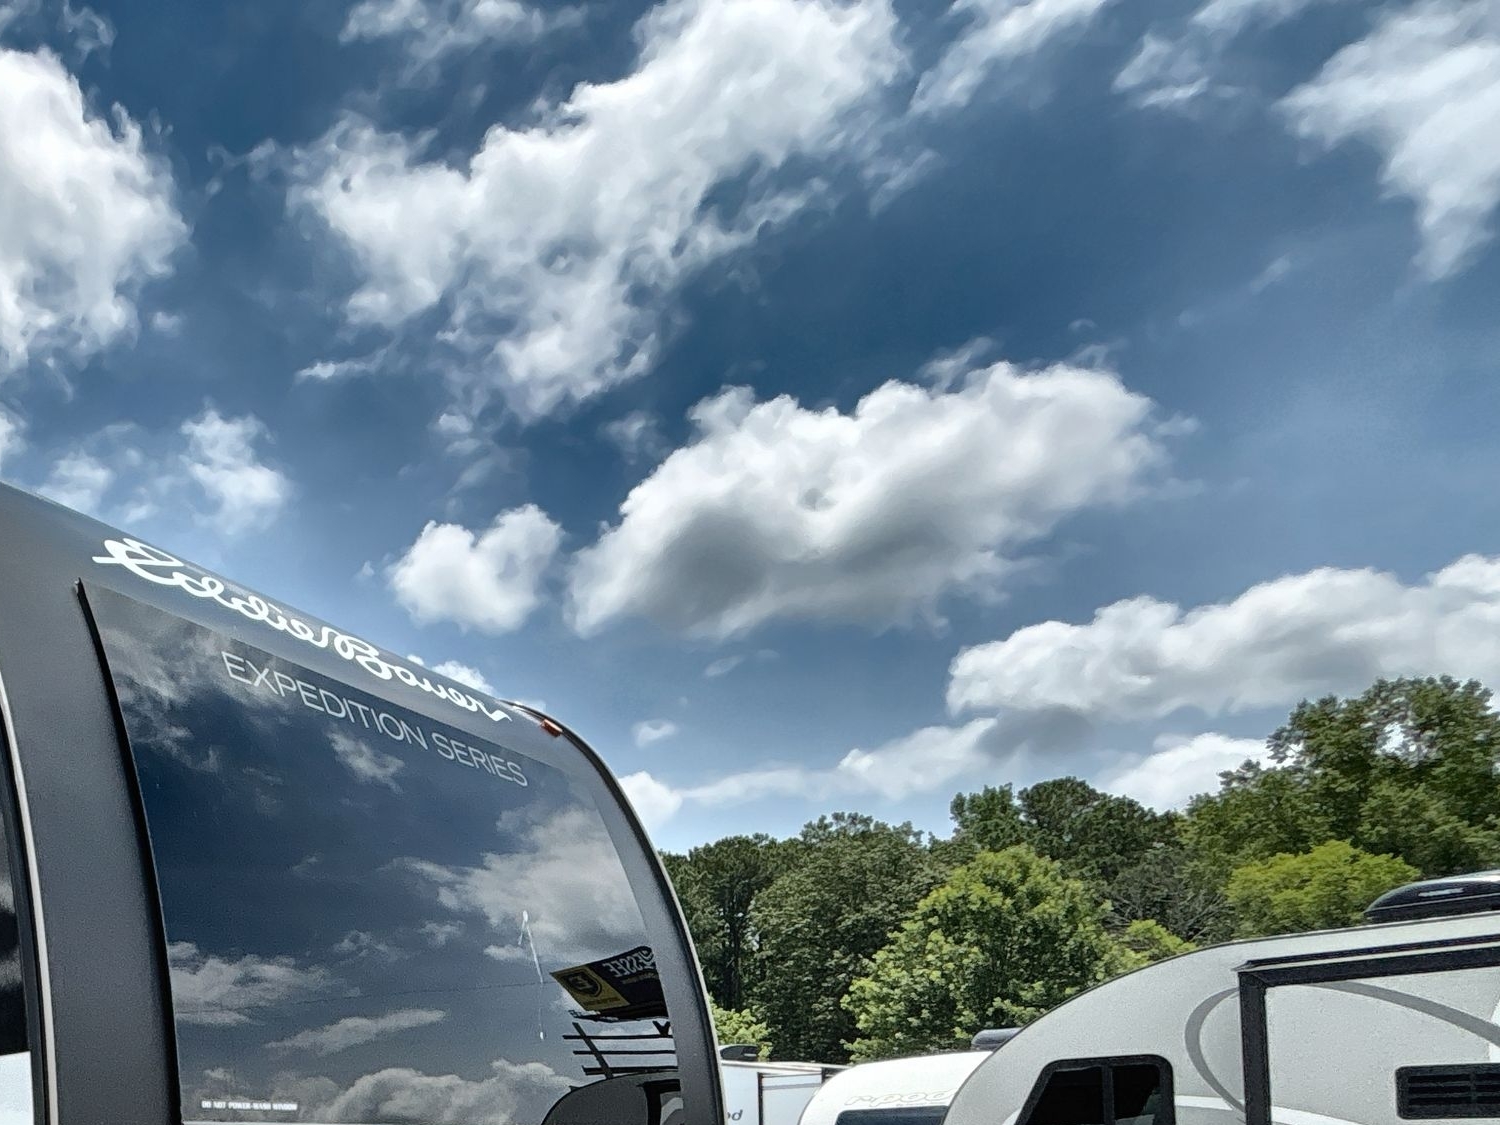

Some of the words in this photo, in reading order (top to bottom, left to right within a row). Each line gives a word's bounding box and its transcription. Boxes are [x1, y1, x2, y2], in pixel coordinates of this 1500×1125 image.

[92, 537, 328, 648] Eddie
[320, 626, 512, 722] Bauer
[221, 650, 429, 751] EXPEDITION
[431, 732, 529, 788] SERIES
